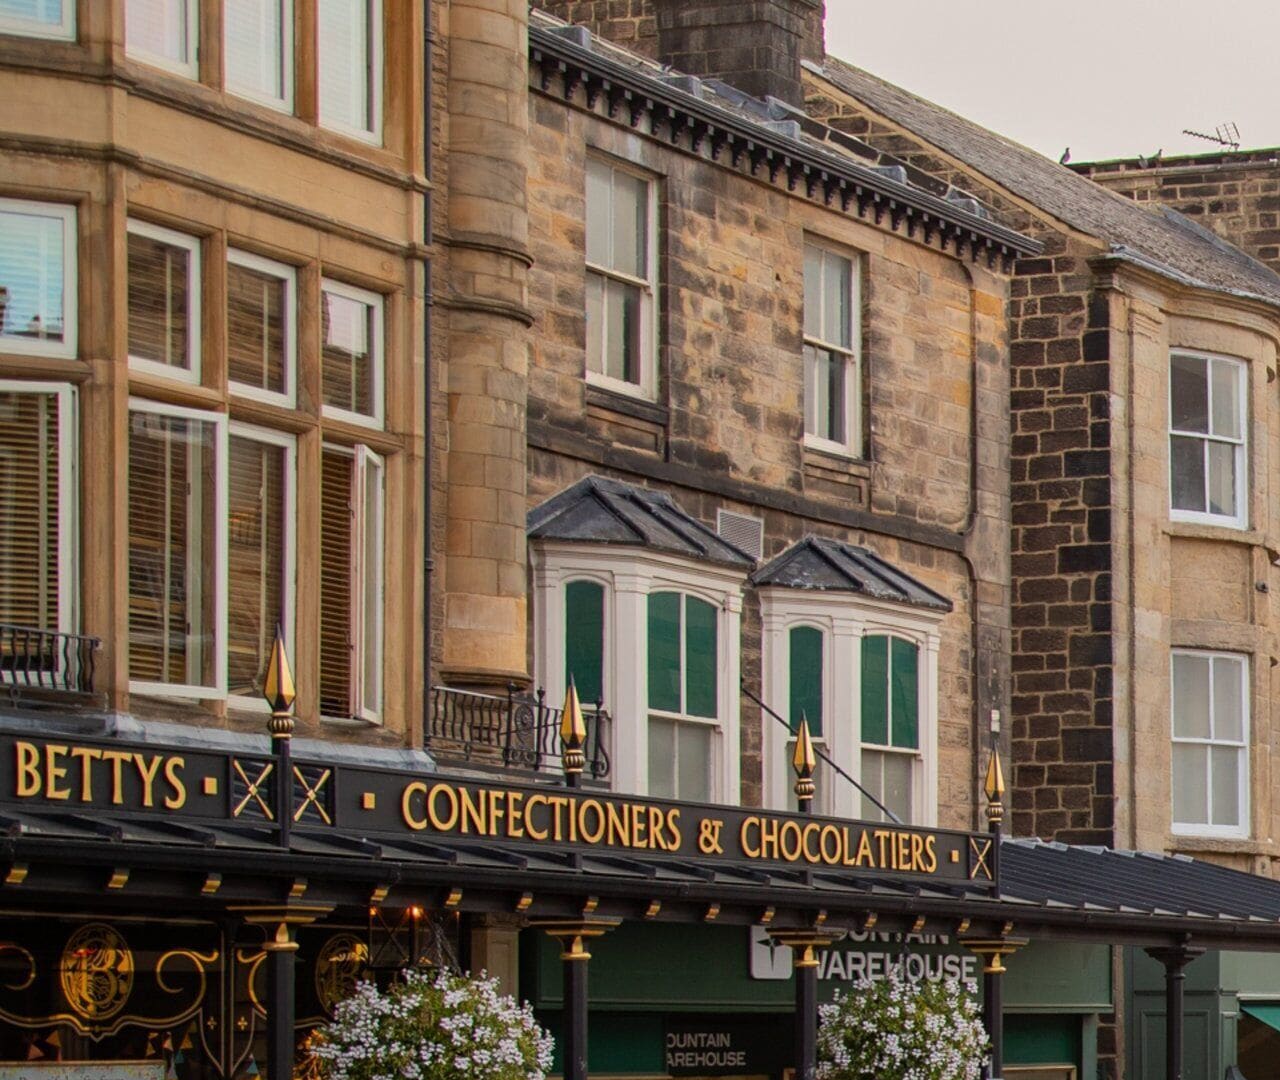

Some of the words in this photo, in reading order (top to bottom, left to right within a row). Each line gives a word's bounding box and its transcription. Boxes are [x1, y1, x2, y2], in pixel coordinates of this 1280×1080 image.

[16, 741, 188, 810] BETTYS
[402, 781, 681, 852] CONFECTIONERS
[699, 818, 724, 854] &
[741, 815, 938, 873] CHOCOLATIERS
[666, 1032, 731, 1049] OUNTAIN
[666, 1051, 747, 1068] AREHOUSE
